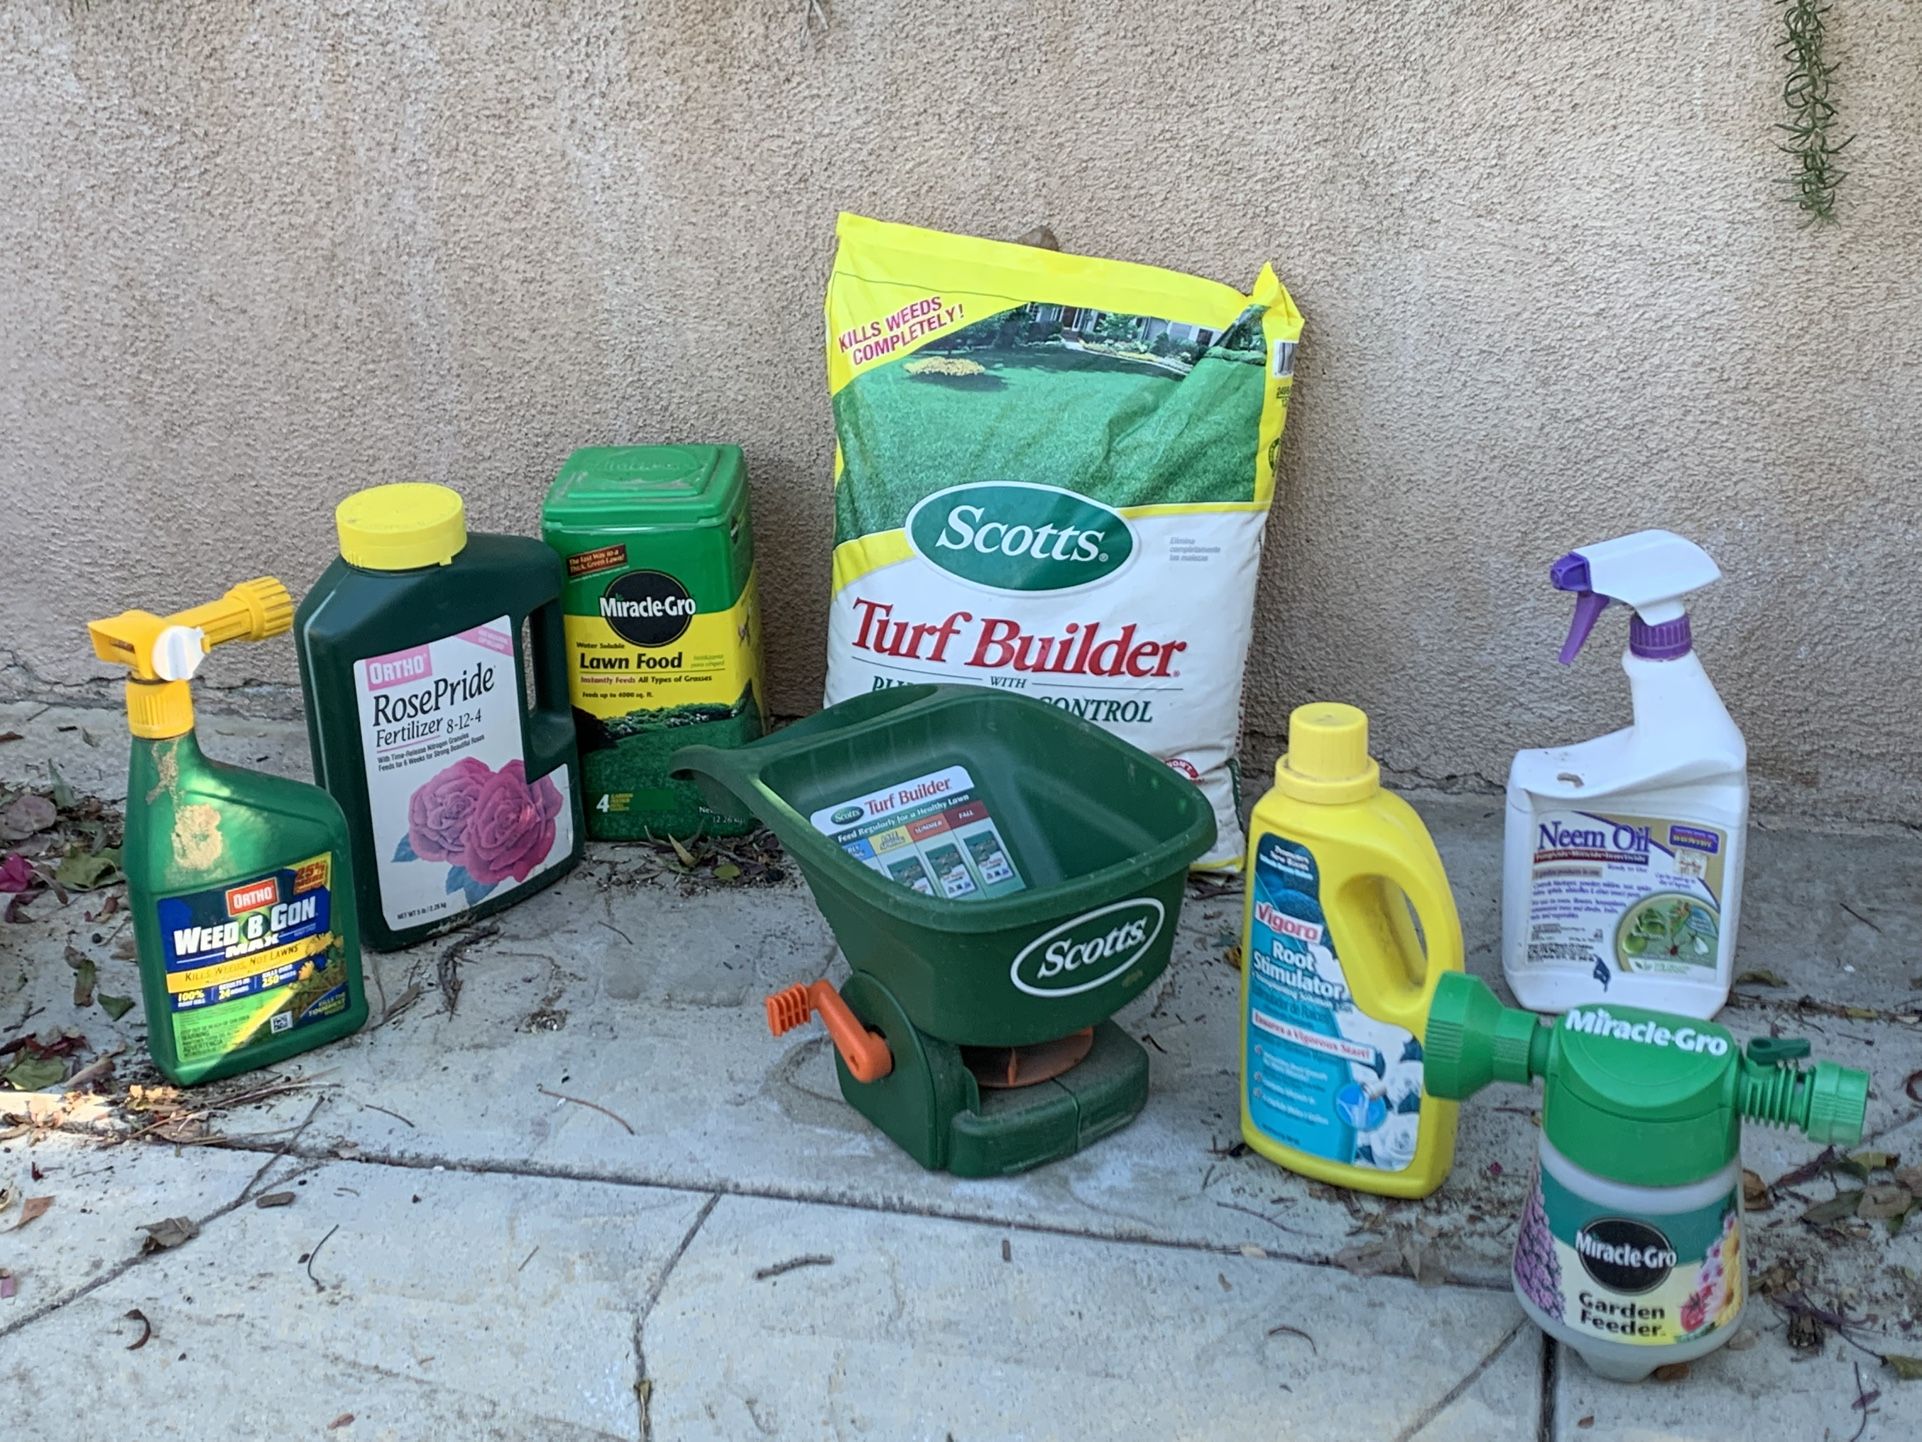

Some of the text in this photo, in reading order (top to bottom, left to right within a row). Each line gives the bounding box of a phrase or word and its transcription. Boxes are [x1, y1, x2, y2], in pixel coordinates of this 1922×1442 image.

[838, 296, 942, 352] KILLS WEEDS
[853, 303, 964, 365] COMPLETELY!
[935, 504, 1104, 562] Scotts
[599, 596, 697, 618] Miracle-Gro
[576, 641, 598, 649] Water
[851, 597, 1187, 678] Turf Builder
[370, 657, 423, 685] ORTHO
[580, 653, 629, 669] Lawn
[636, 652, 683, 669] Food
[372, 662, 495, 726] RosePride
[580, 676, 613, 684] Instantly
[650, 675, 672, 684] Types
[989, 676, 1027, 690] WITH
[376, 709, 482, 747] Fertilizer 8-12-4
[596, 794, 610, 812] 4
[834, 778, 951, 823] Scotts Turf Builder
[838, 831, 857, 843] Feed
[858, 817, 896, 838] Regularly
[897, 812, 909, 824] for
[917, 802, 947, 816] Healthy
[948, 794, 970, 806] Lawn
[1538, 821, 1607, 850] Neem
[1613, 825, 1650, 852] Oil
[233, 886, 273, 907] ORTHO
[173, 921, 239, 956] WEED
[247, 914, 263, 934] B
[270, 896, 316, 932] GON
[1256, 902, 1319, 941] Vigoro
[224, 932, 280, 958] MAX
[269, 945, 299, 961] LAWNS
[1037, 916, 1148, 979] Scotts
[1272, 940, 1316, 971] Root
[1254, 951, 1345, 1000] Stimulator
[178, 990, 205, 1001] 100%
[1565, 1008, 1728, 1057] Miracle-Gro
[1576, 1231, 1677, 1269] Miracle-Gro
[1579, 1292, 1665, 1320] Garden
[1580, 1308, 1663, 1337] Feeder
